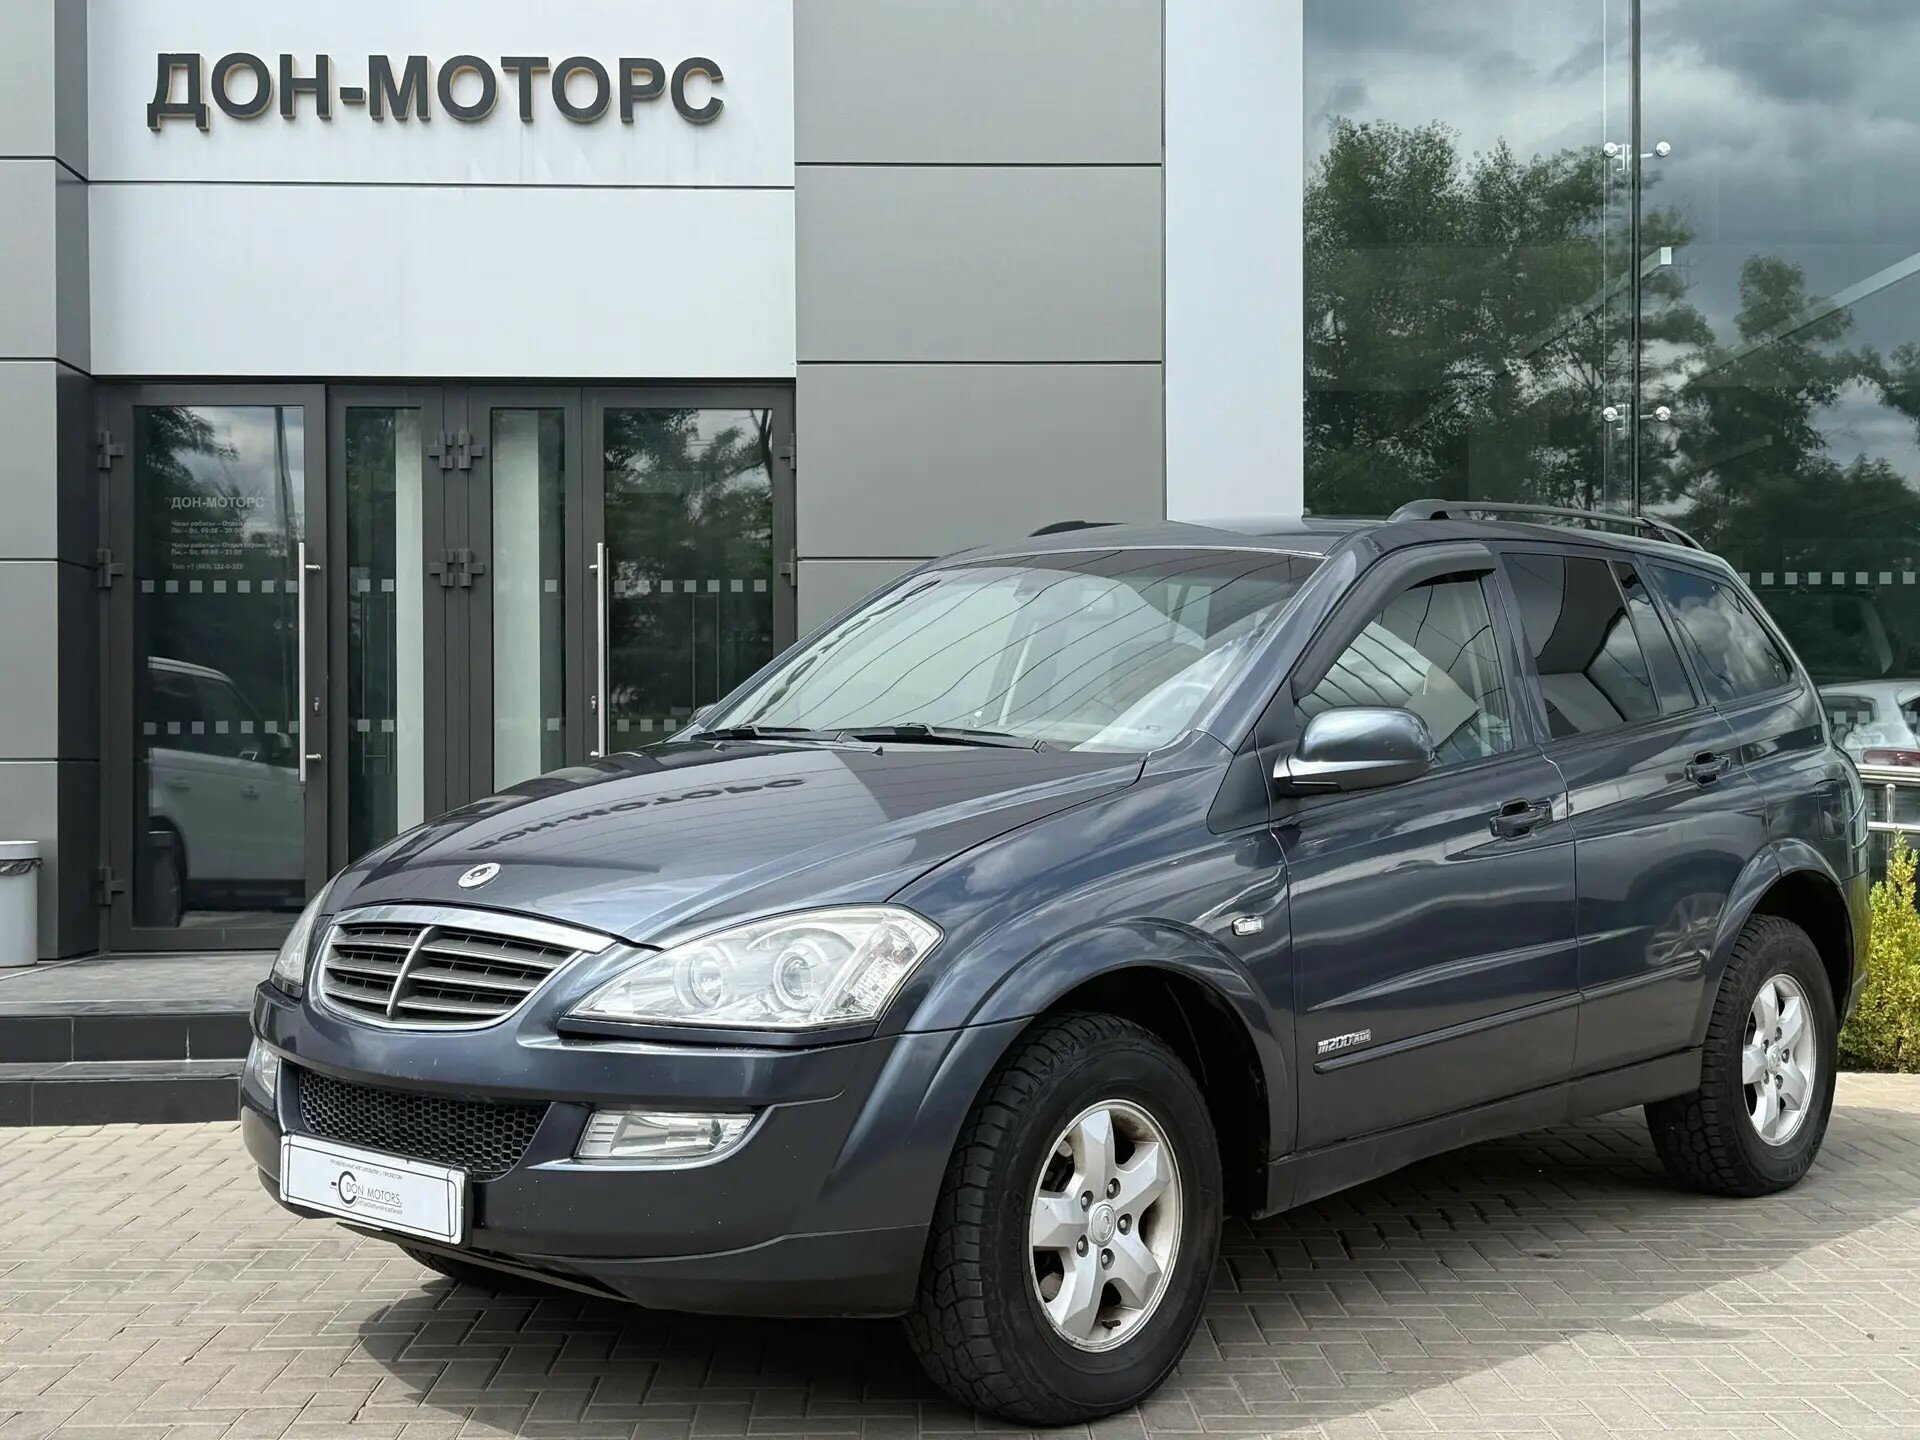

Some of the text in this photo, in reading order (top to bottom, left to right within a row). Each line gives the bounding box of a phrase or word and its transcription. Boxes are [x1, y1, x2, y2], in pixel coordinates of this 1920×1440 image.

[147, 52, 725, 132] ДОН-МОТОРС
[171, 496, 265, 510] ДОН-МОТОРС
[346, 1182, 401, 1205] DON MOTORS
